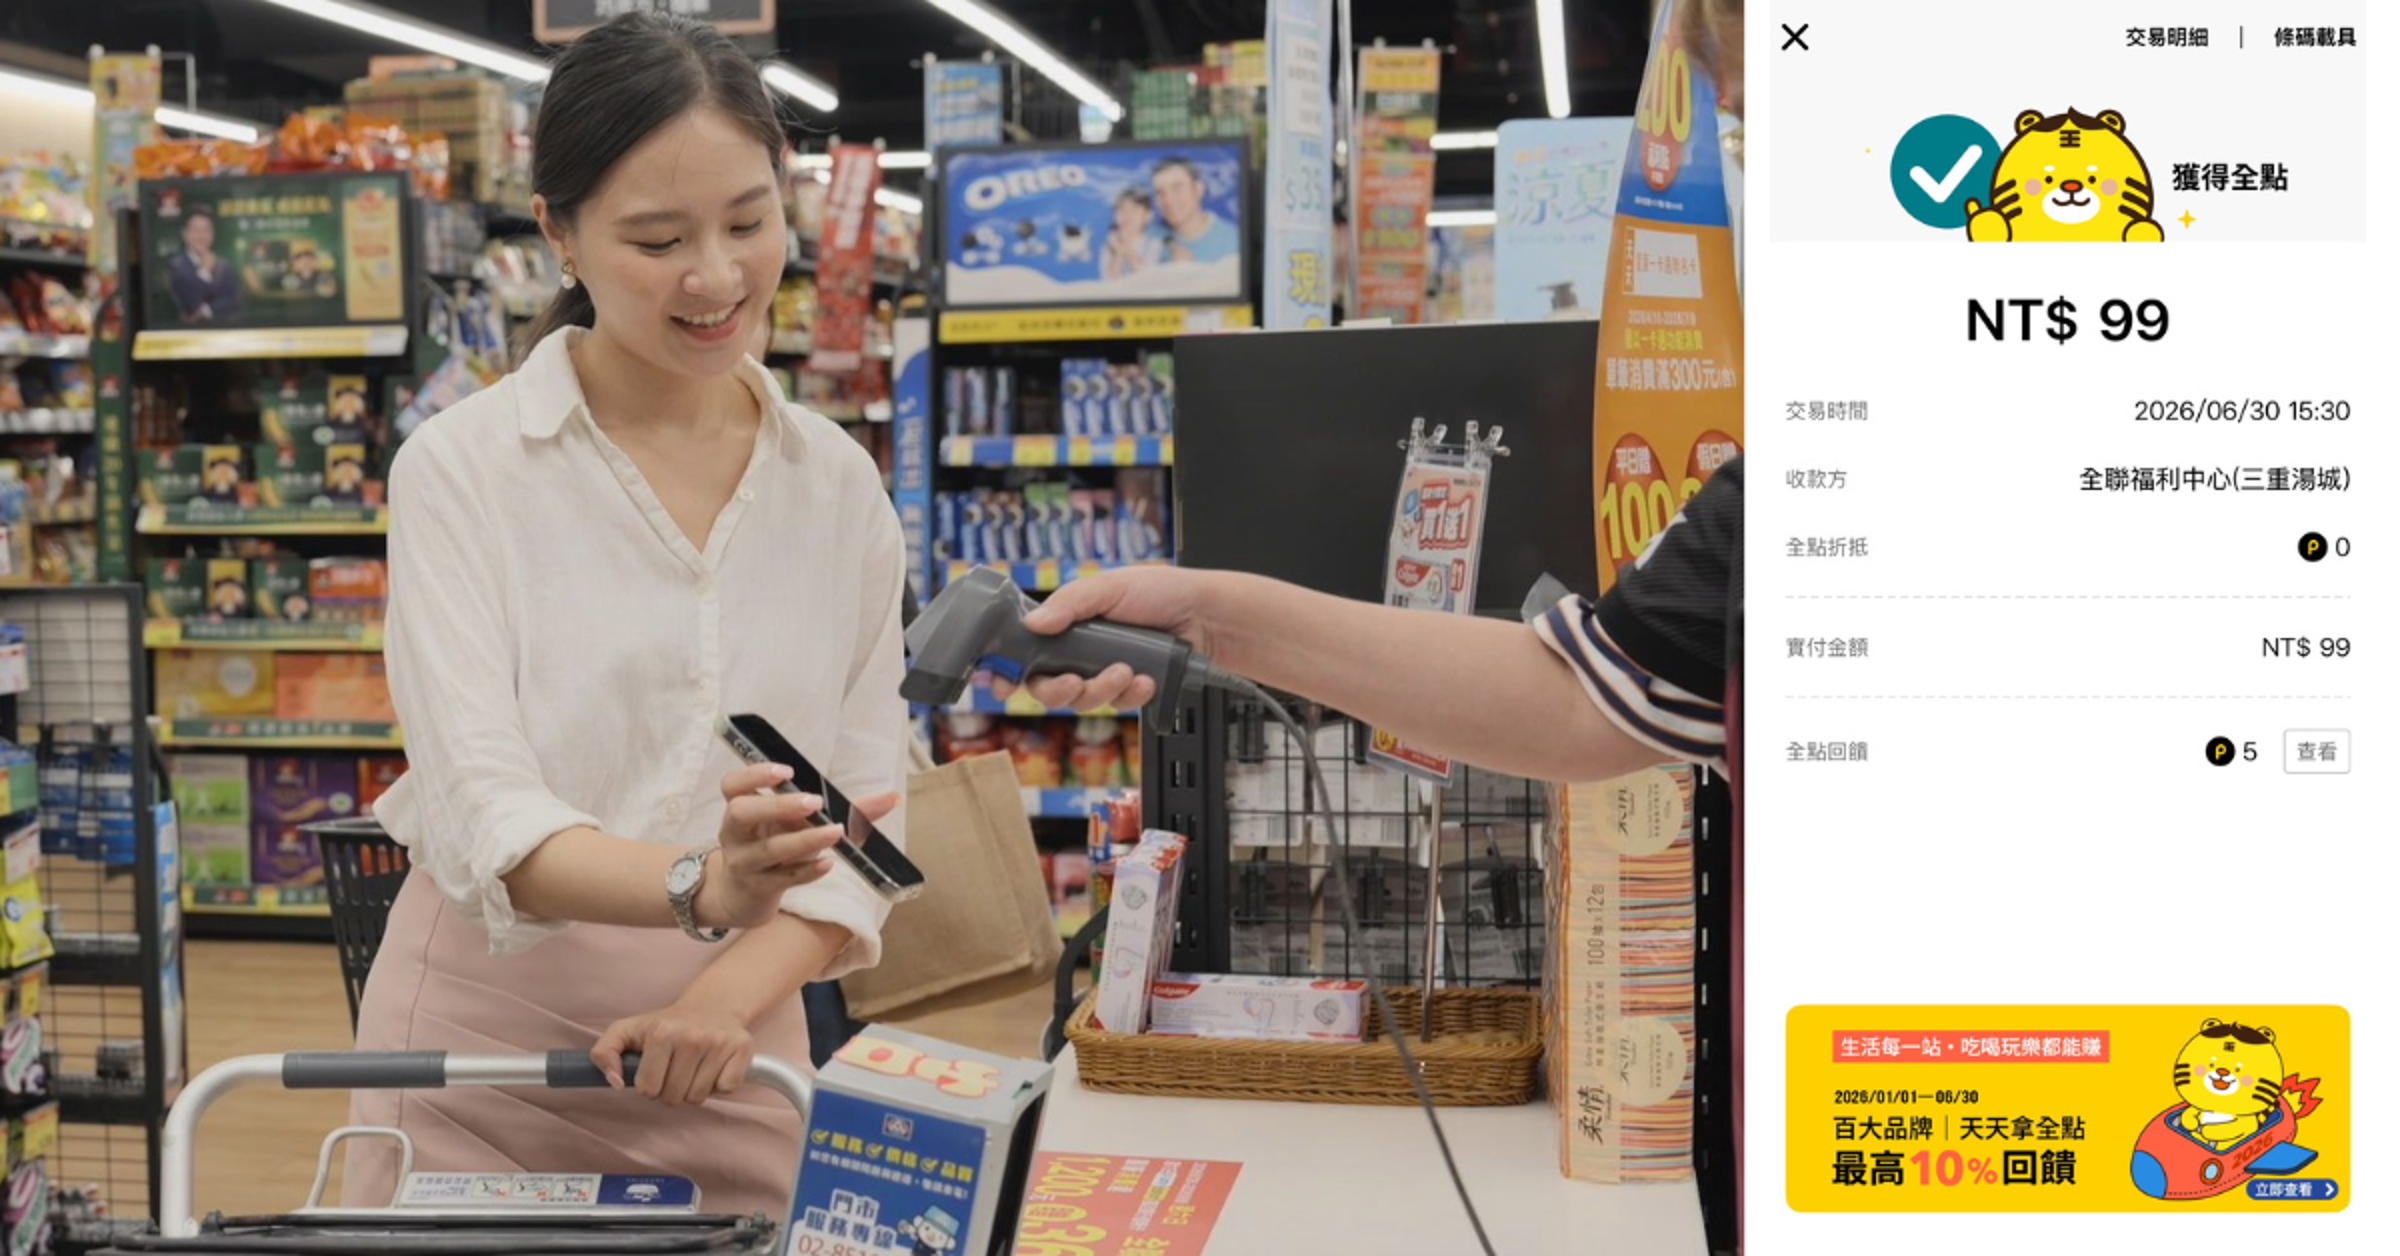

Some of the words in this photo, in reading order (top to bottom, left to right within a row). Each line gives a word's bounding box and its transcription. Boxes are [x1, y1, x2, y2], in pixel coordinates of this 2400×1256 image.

[2126, 26, 2209, 48] 交易明細
[2274, 26, 2358, 48] 條碼載具
[963, 164, 1088, 211] OREO
[2172, 162, 2290, 192] 獲得全點
[1968, 295, 2078, 346] NT$
[2099, 298, 2170, 343] 99
[1786, 400, 1868, 421] 交易時間
[2135, 398, 2281, 424] 2026/06/30
[2288, 399, 2351, 422] 15:30
[1786, 468, 1848, 489] 收款方
[2080, 466, 2351, 493] 全聯福利中心(三重湯城)
[1786, 536, 1868, 557] 全點折抵
[2335, 536, 2351, 558] 0
[1786, 637, 1868, 658] 實付金額
[2263, 636, 2312, 659] NT$
[2320, 637, 2351, 658] 99
[1786, 741, 1868, 762] 全點回饋
[2243, 741, 2258, 762] 5
[2297, 741, 2337, 762] 查看
[1153, 984, 1192, 997] Colgate
[1577, 1085, 1605, 1145] 柔情
[1833, 1115, 1934, 1141] 百大品牌
[1959, 1115, 2087, 1141] 天天拿全點
[2232, 1132, 2274, 1169] 2026
[1832, 1149, 2077, 1187] 最高10%回饋
[2255, 1181, 2313, 1197] 立即查看
[832, 1190, 877, 1220] 門市
[805, 1209, 895, 1249] 服務專線
